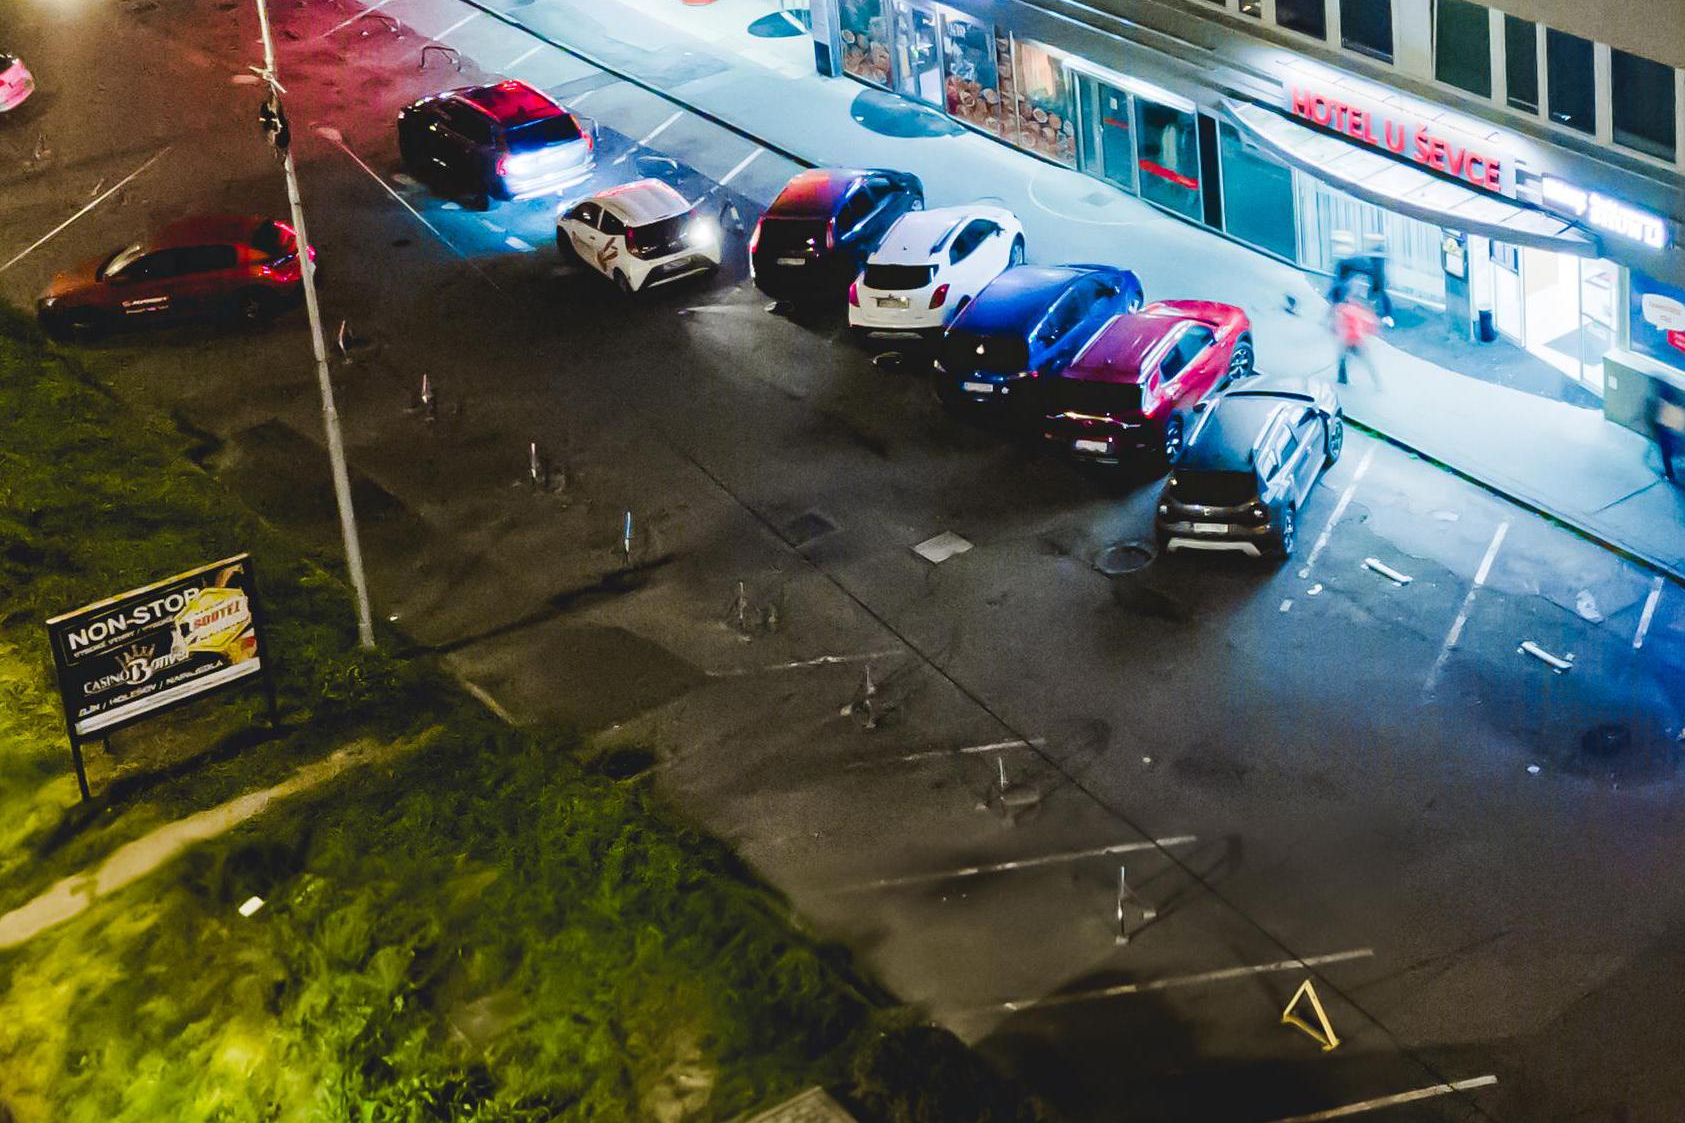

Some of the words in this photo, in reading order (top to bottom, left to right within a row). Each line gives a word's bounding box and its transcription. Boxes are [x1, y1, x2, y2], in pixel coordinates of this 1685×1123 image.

[1291, 86, 1379, 145] HOTEL
[1384, 118, 1406, 154] U
[67, 587, 200, 651] NON-STOP
[83, 670, 130, 695] CASINO
